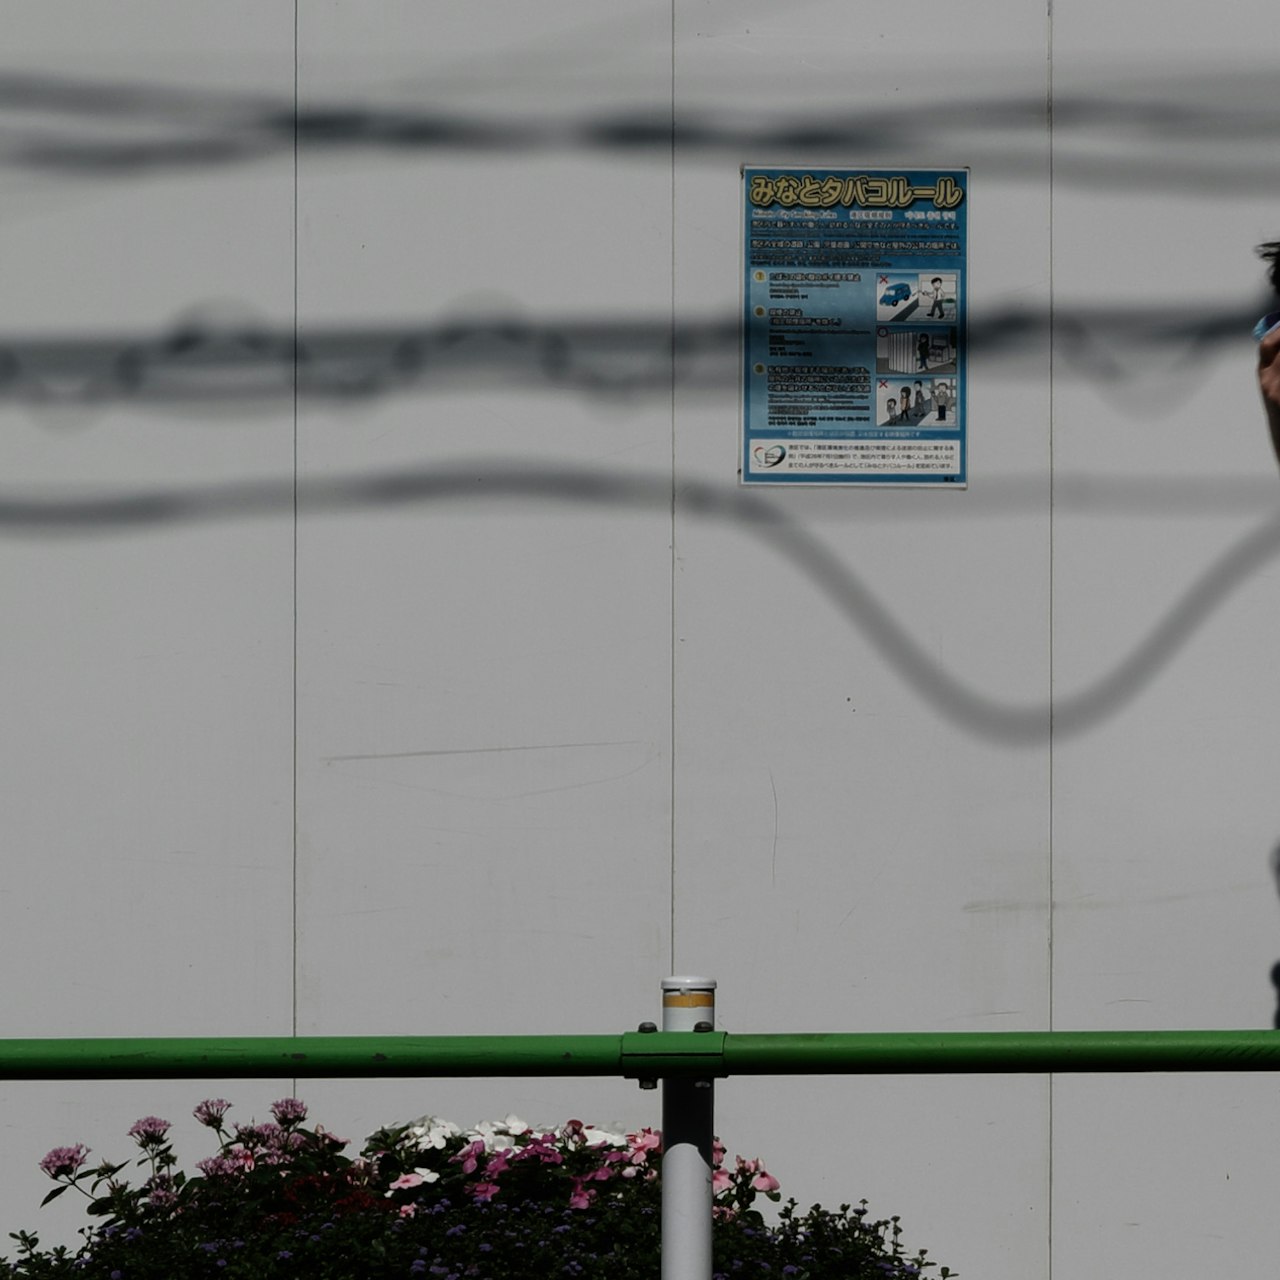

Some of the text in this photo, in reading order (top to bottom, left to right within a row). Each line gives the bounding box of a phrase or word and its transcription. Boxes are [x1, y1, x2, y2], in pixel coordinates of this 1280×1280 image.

[750, 174, 964, 208] みなとタバコルール
